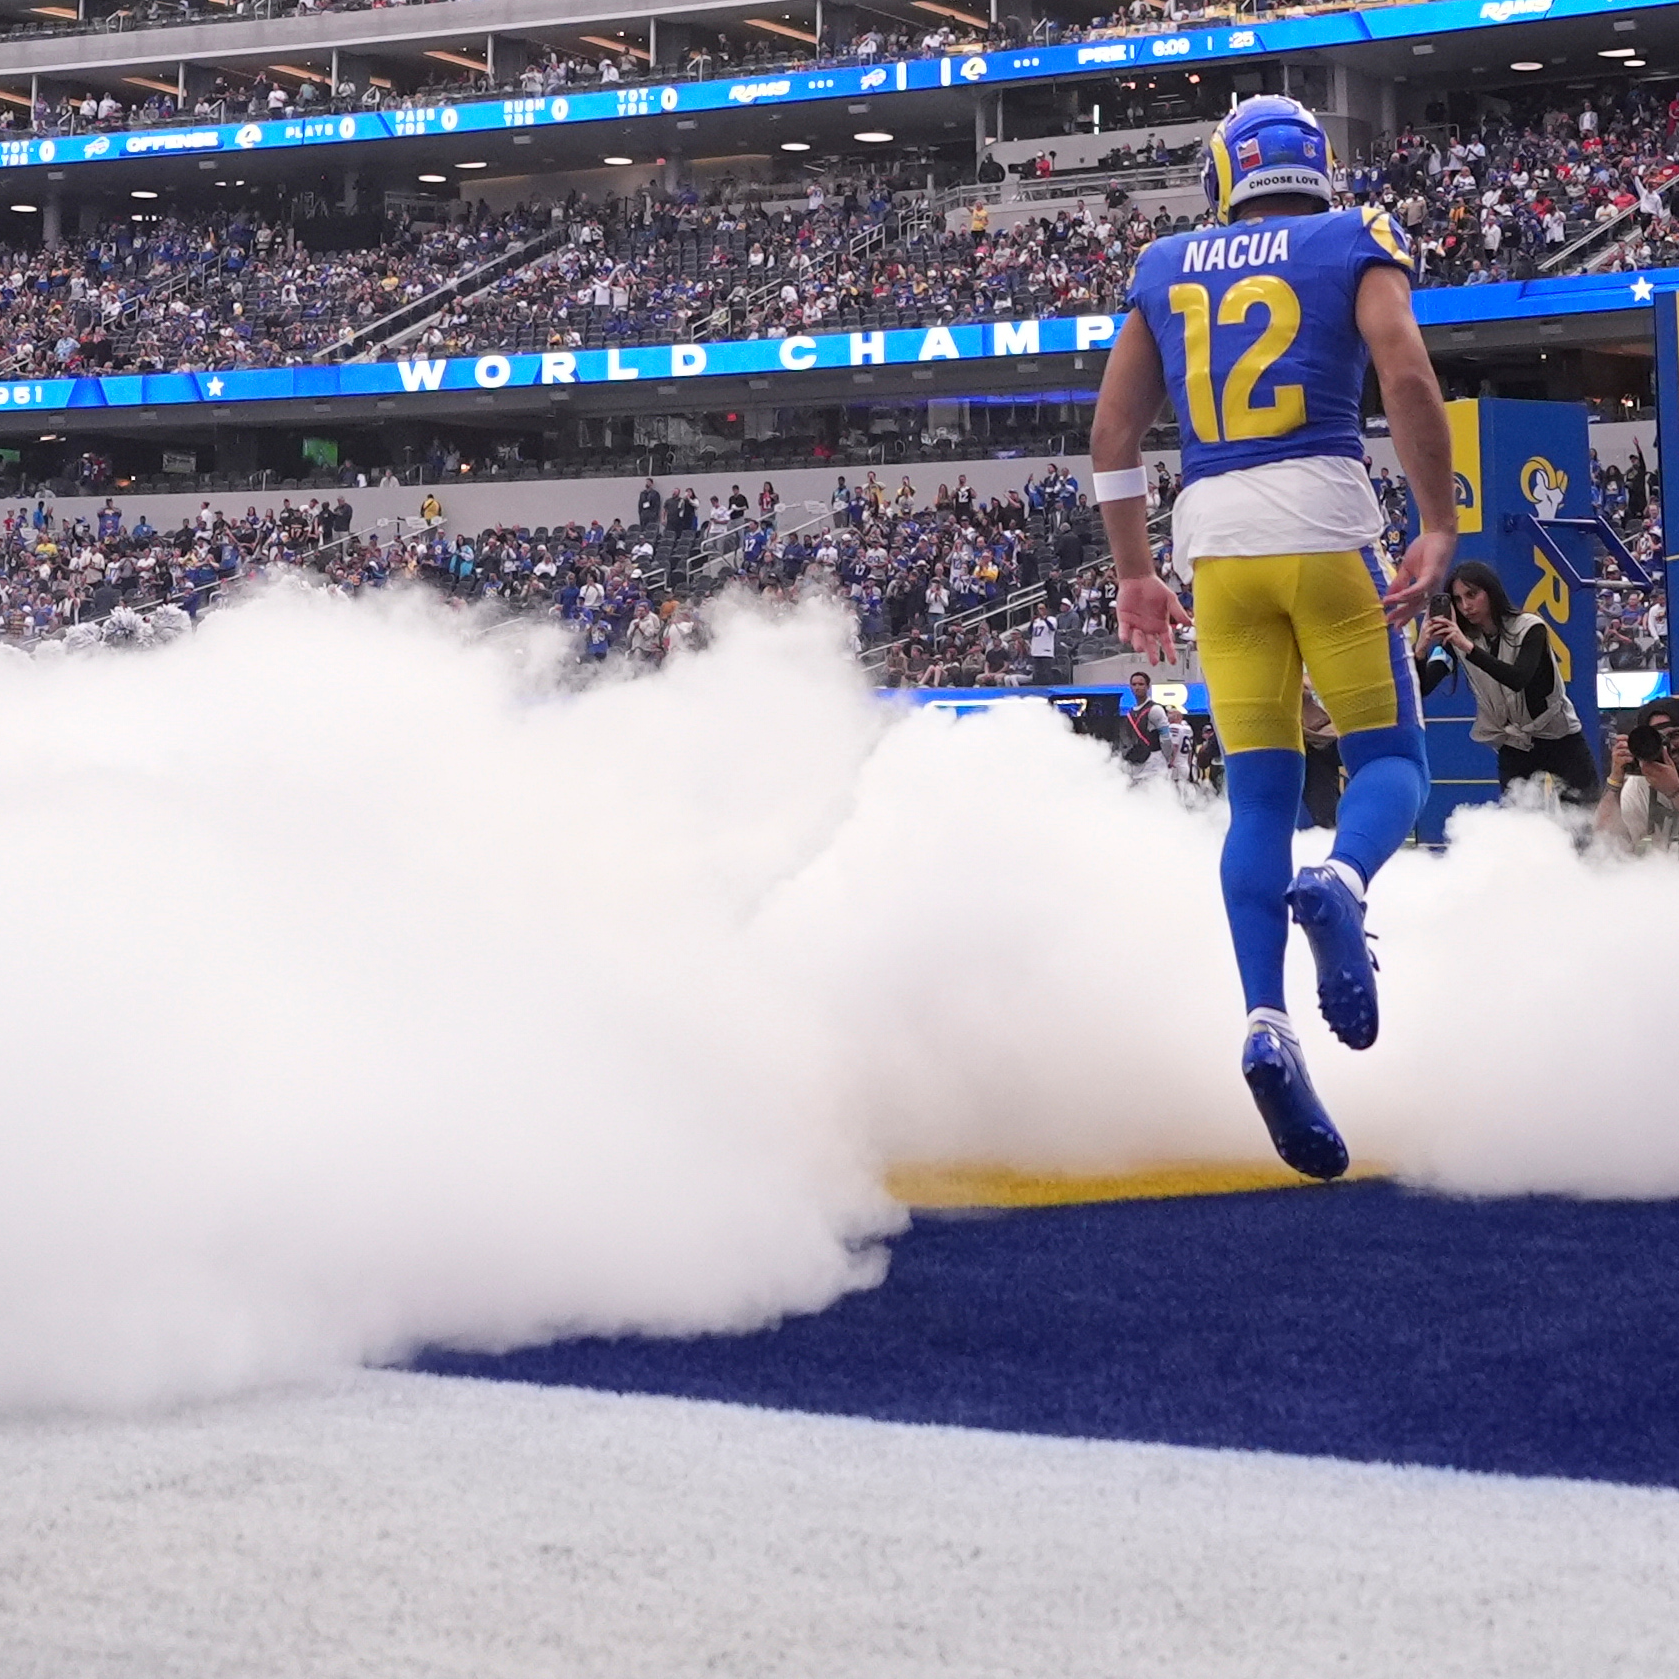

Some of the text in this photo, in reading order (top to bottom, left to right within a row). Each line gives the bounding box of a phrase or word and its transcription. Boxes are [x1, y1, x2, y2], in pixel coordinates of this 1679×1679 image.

[728, 80, 791, 103] RAMS
[126, 132, 219, 153] OFFENSE
[285, 124, 333, 139] PLAYS
[1249, 176, 1319, 189] CHOOSE LOVE
[1182, 229, 1289, 273] NACUA
[397, 343, 708, 393] WORLD
[1168, 275, 1307, 444] 12
